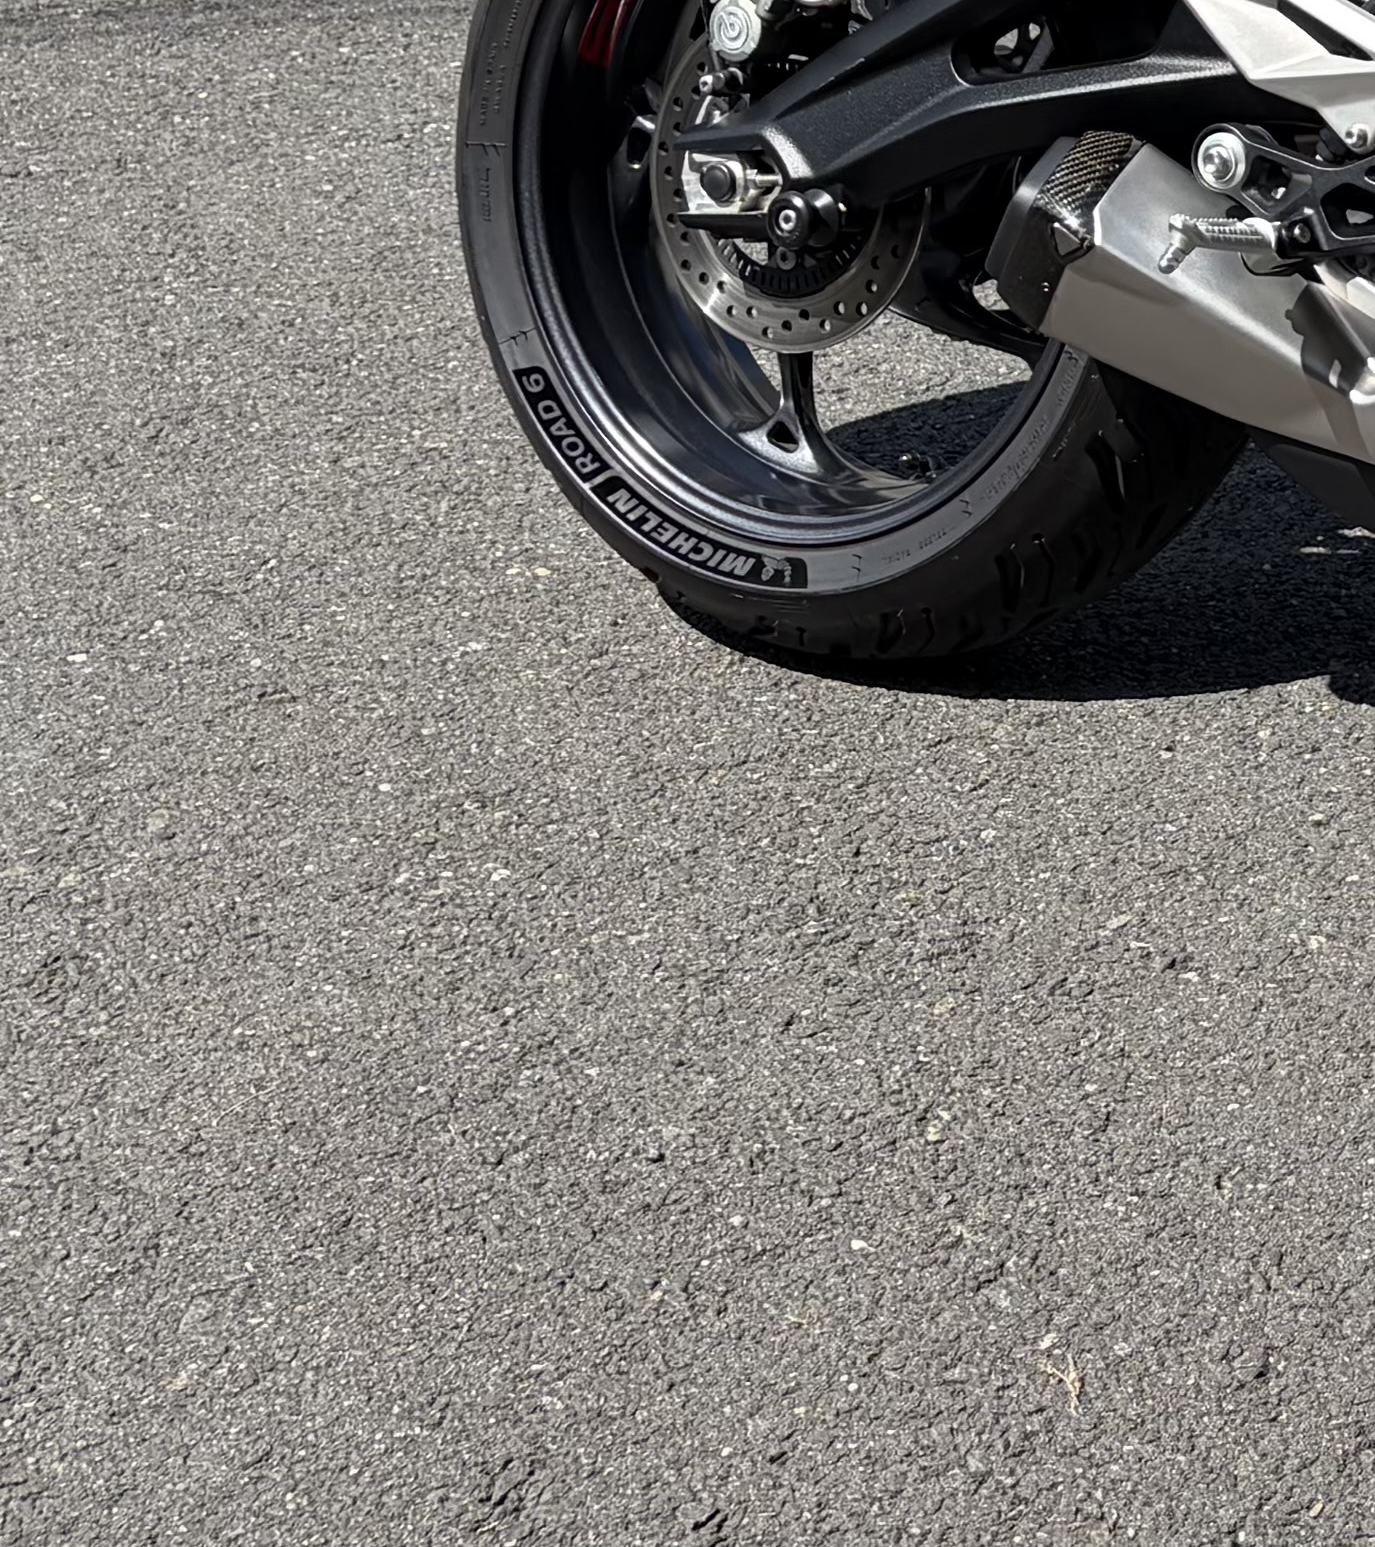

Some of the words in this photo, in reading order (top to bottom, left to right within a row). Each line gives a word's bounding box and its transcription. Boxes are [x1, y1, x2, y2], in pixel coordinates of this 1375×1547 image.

[521, 372, 546, 394] 6
[537, 399, 601, 475] ROAD
[605, 487, 757, 577] MICHELIN
